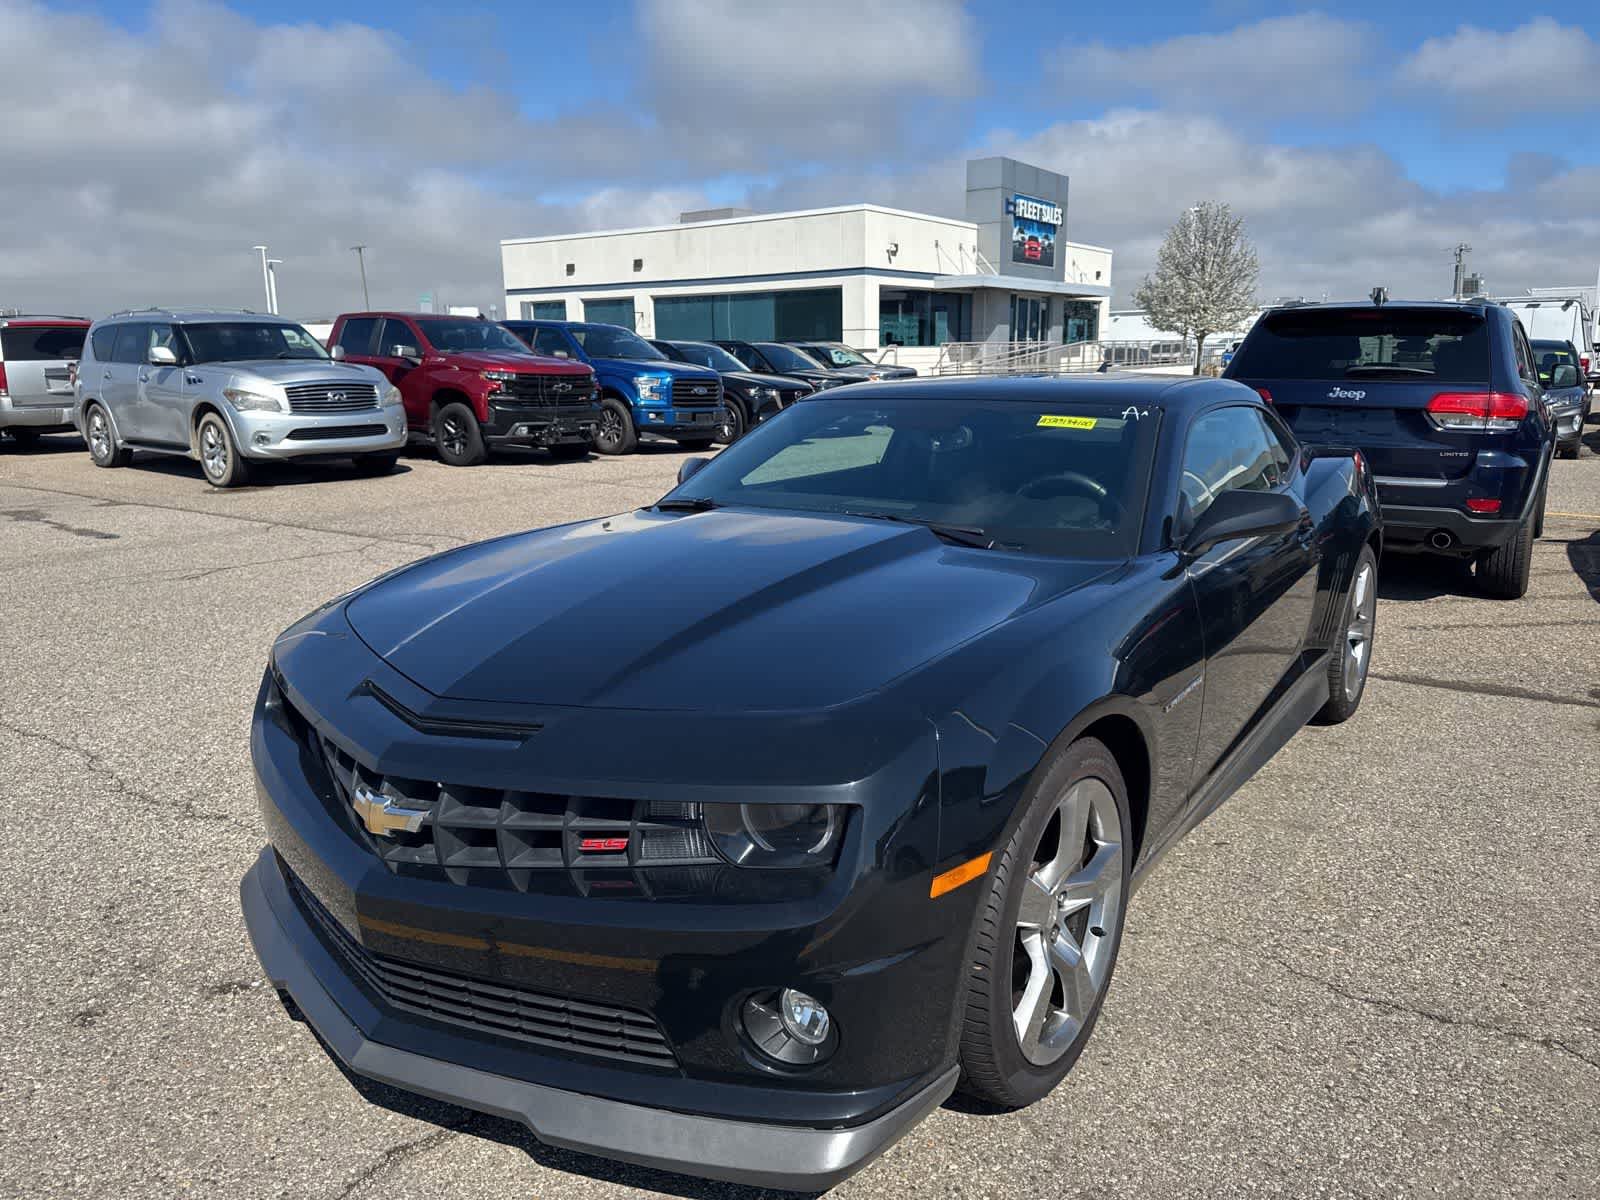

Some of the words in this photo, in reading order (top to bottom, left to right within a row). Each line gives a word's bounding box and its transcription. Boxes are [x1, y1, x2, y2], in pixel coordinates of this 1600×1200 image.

[1019, 199, 1041, 221] FLEET
[1042, 204, 1063, 225] SALES
[1328, 387, 1366, 401] Jeep
[578, 838, 629, 850] SS
